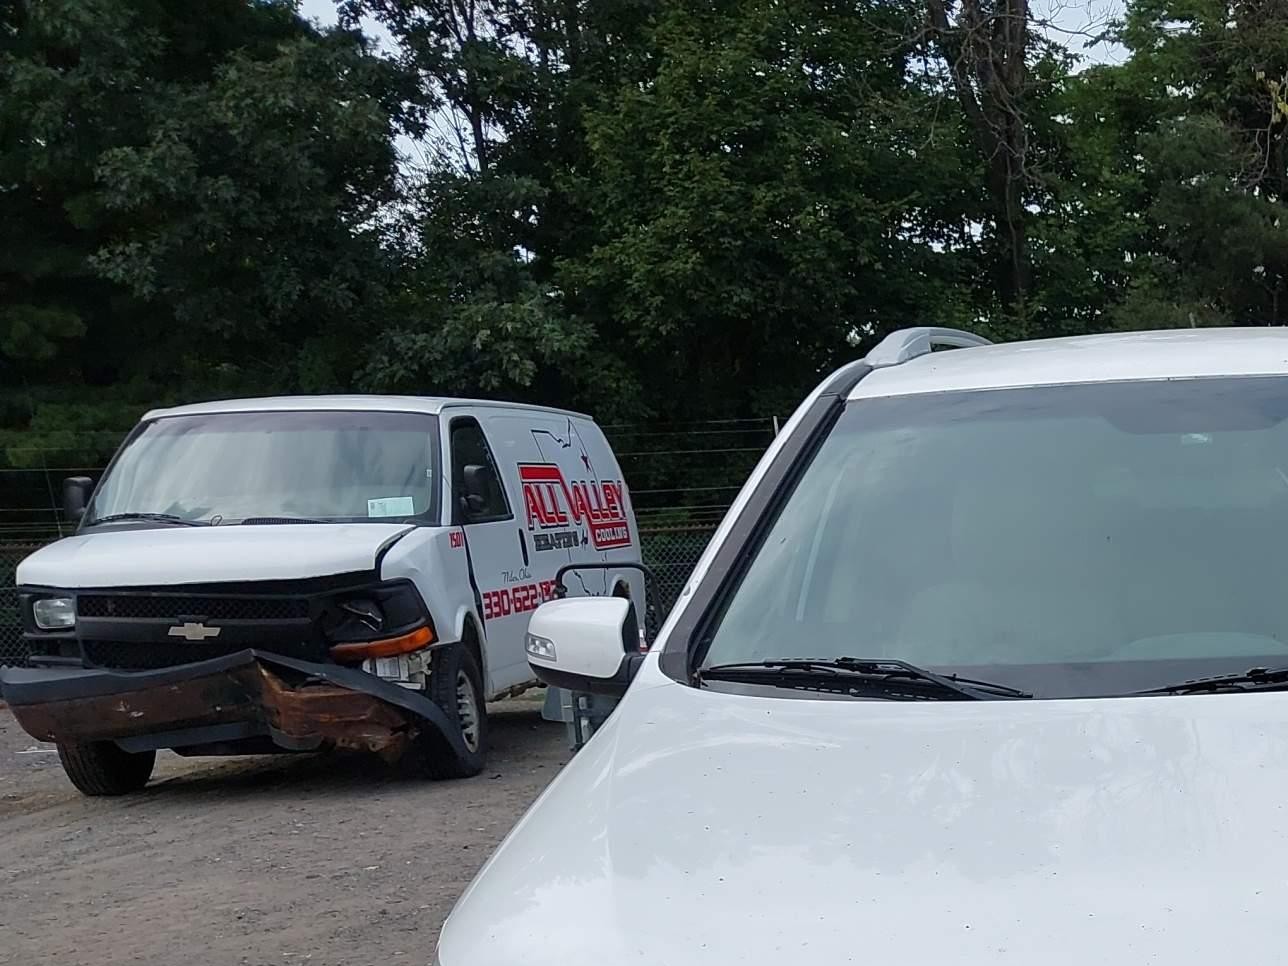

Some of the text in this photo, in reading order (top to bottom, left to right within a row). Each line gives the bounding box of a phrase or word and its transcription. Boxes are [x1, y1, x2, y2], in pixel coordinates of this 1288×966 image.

[522, 479, 627, 530] ALL VALLEY
[449, 531, 464, 548] 1501
[595, 526, 628, 542] COOLING
